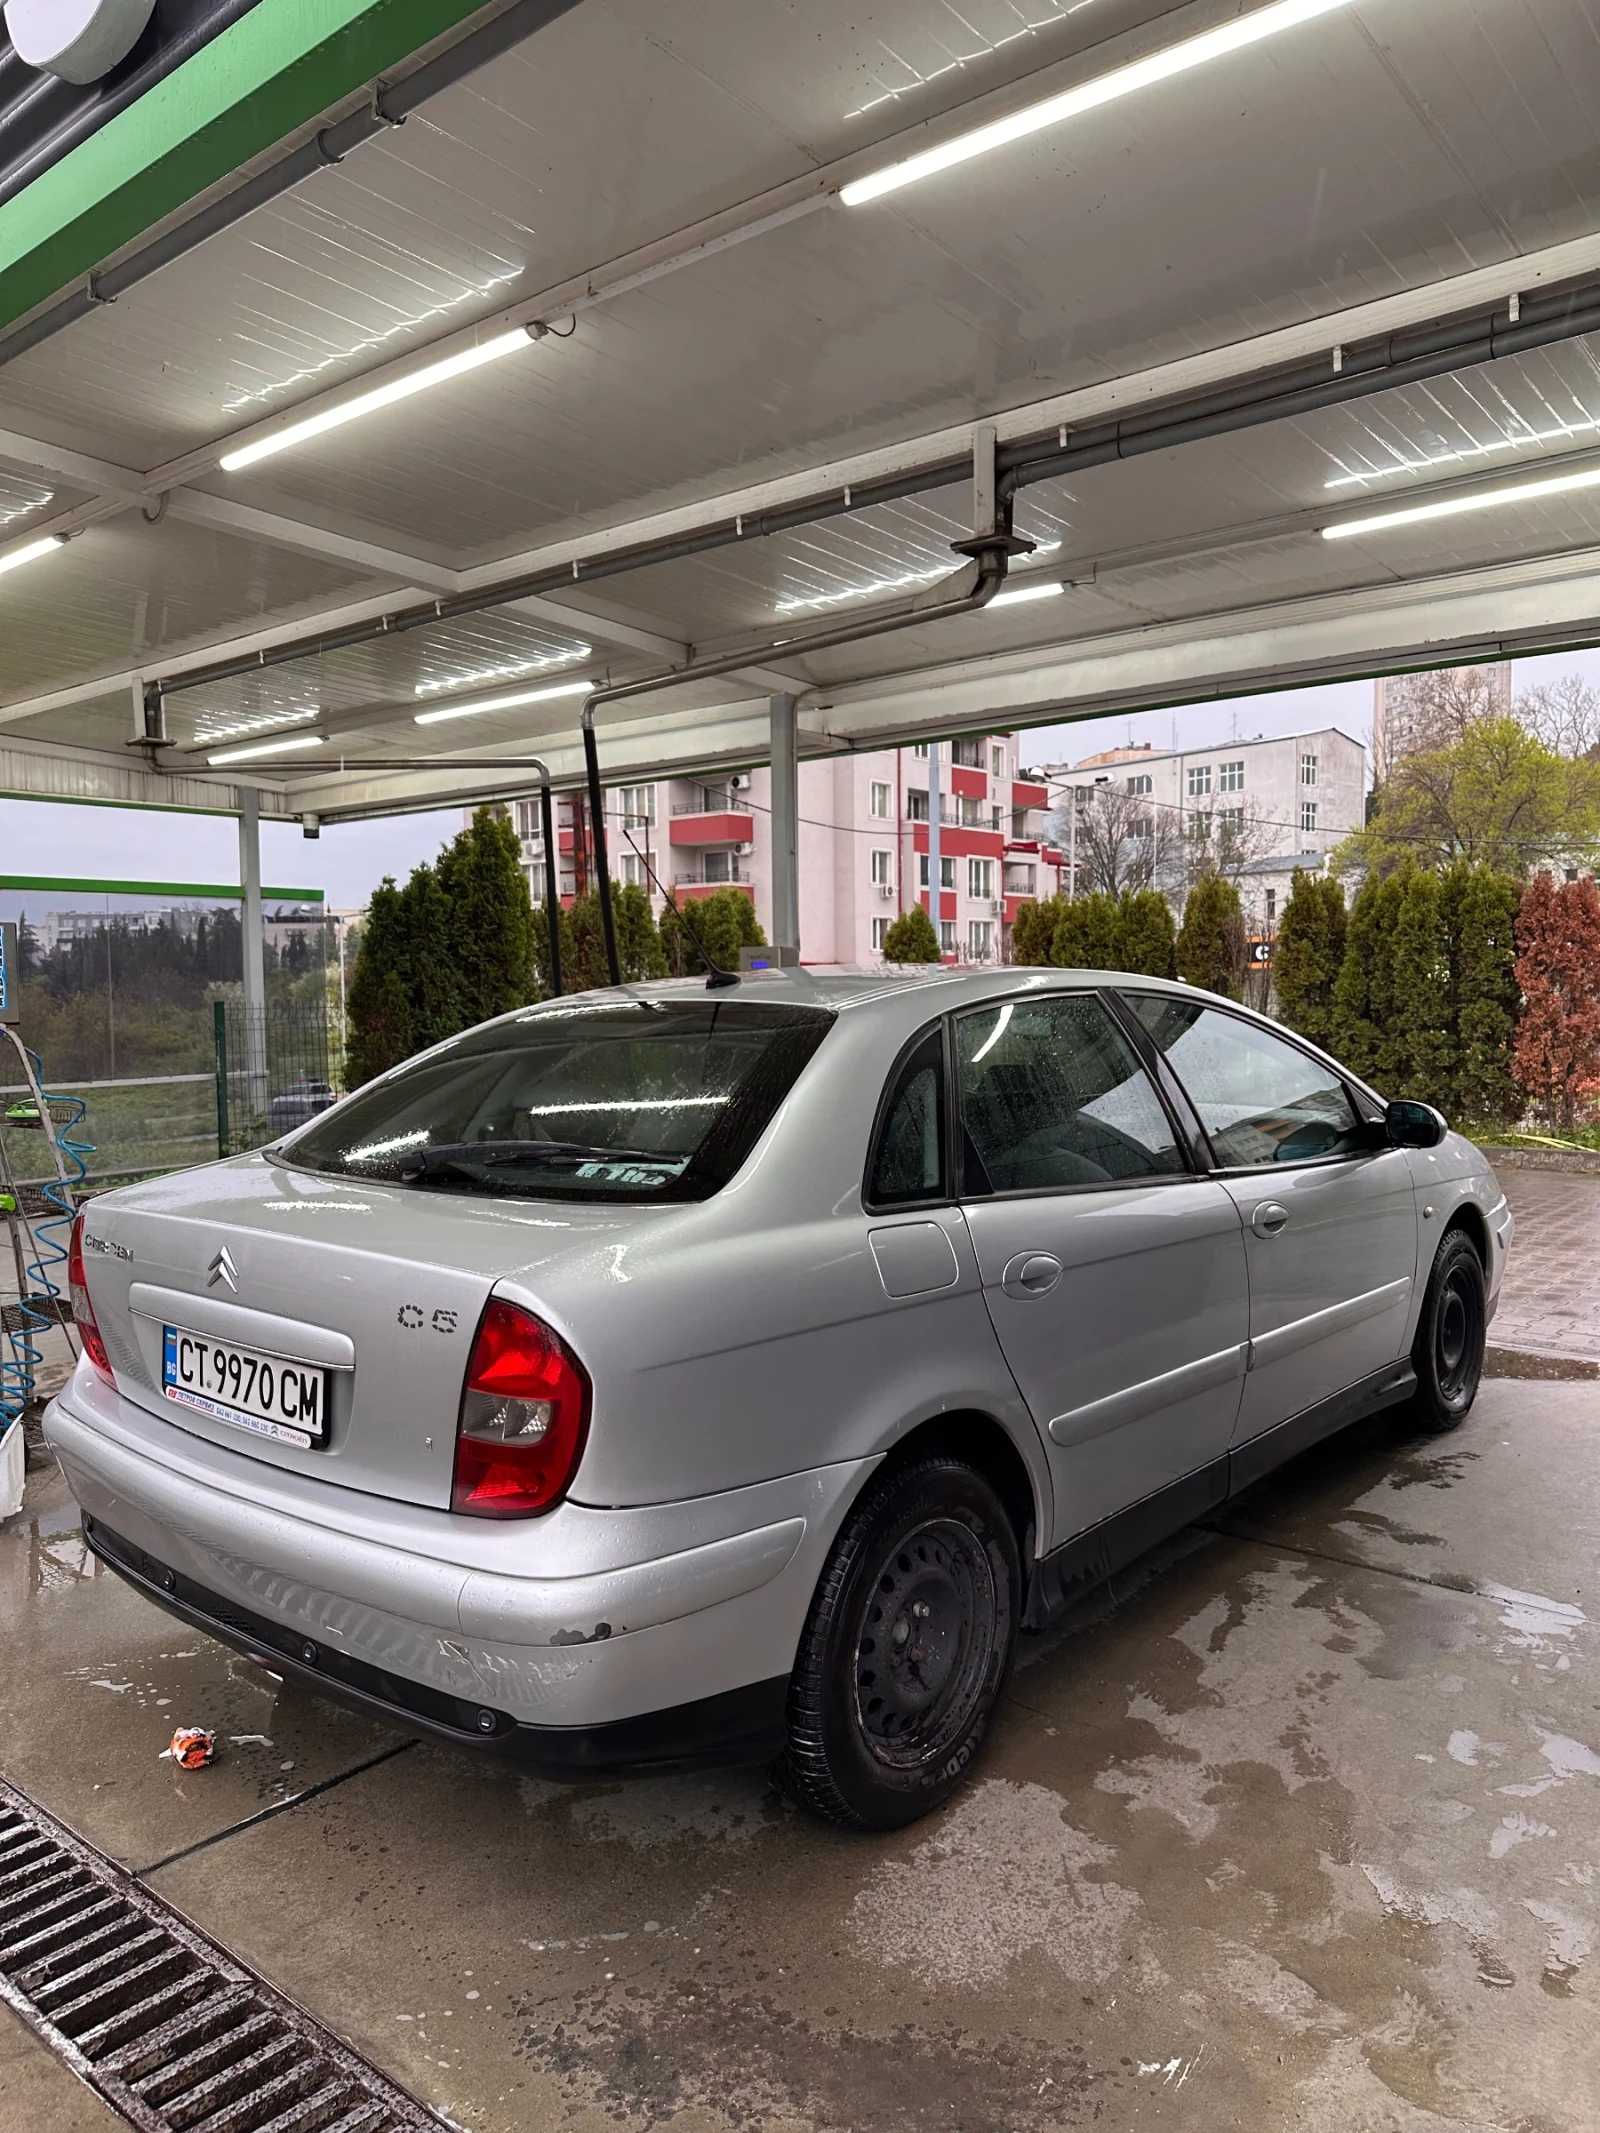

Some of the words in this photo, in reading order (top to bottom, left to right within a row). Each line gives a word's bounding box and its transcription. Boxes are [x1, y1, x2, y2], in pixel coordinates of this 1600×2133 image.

[166, 1361, 176, 1375] BG
[179, 1337, 209, 1388] CT
[213, 1349, 274, 1410] 9970
[280, 1369, 318, 1425] CM
